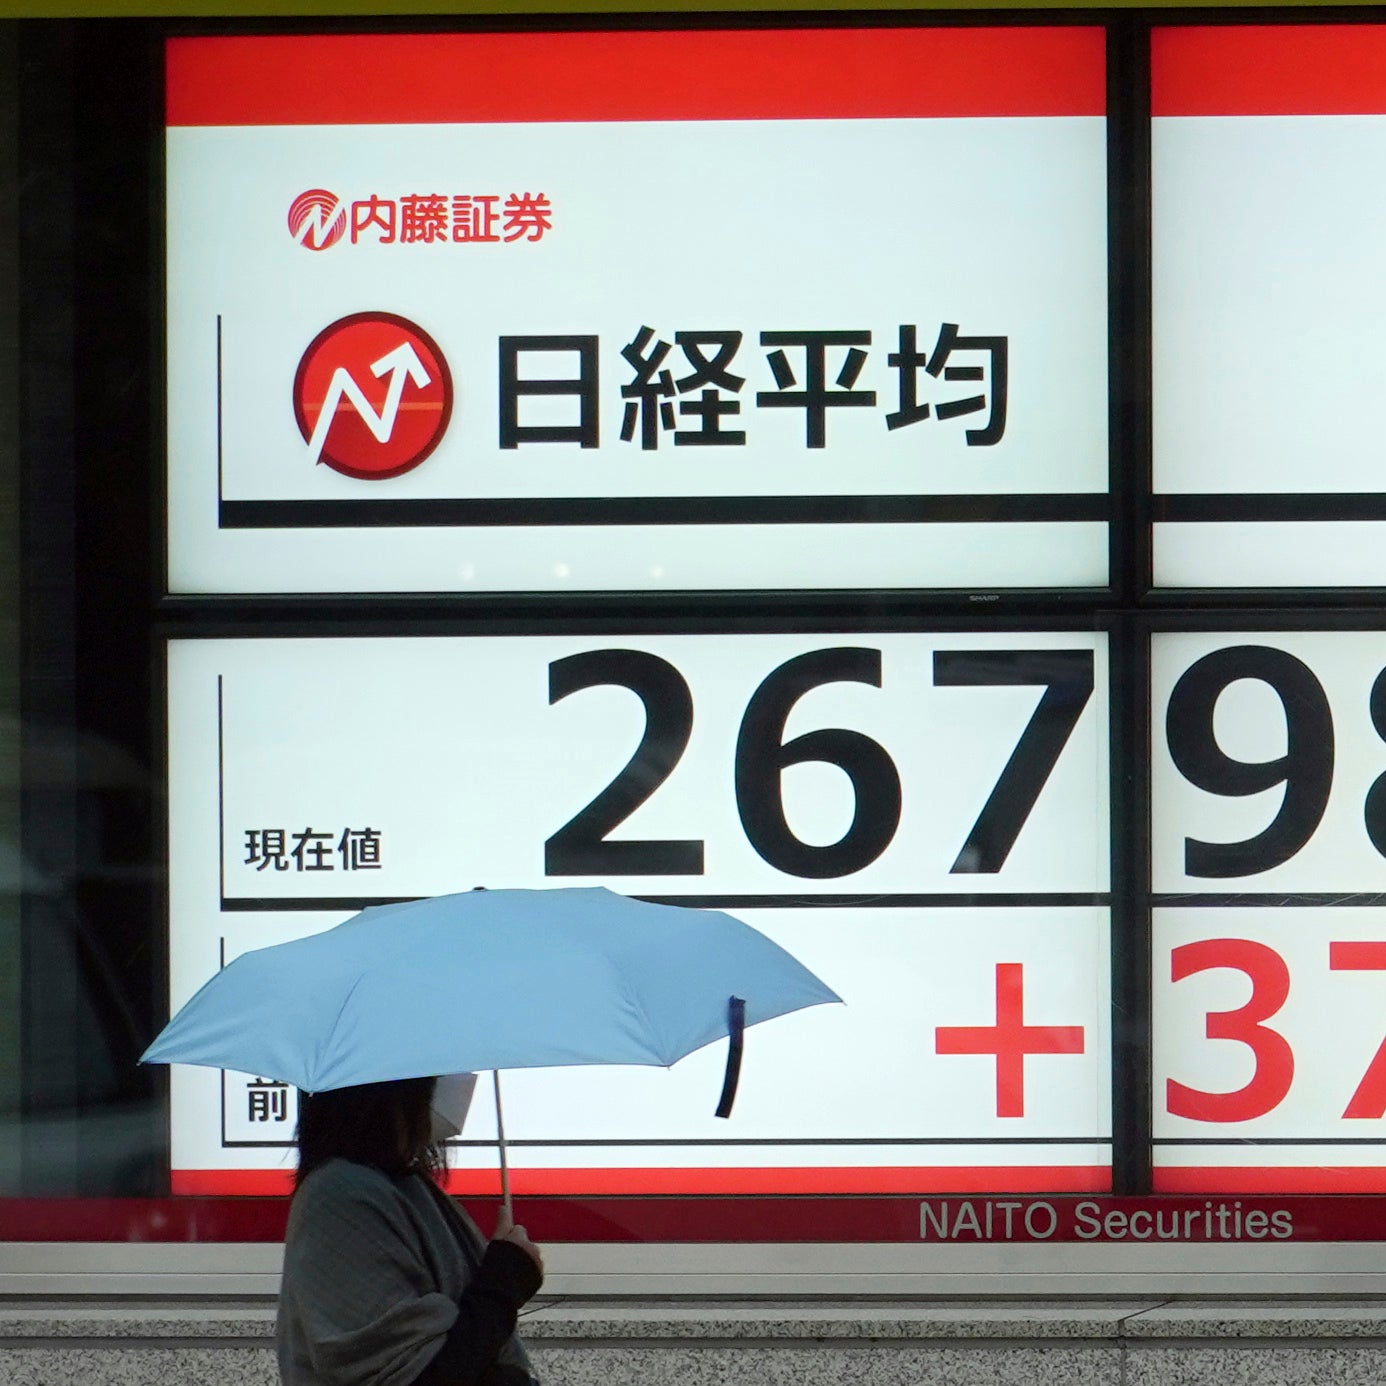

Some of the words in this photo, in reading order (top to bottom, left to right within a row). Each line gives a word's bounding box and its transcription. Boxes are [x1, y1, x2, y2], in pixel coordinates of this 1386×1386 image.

[351, 193, 551, 243] 内藤証券
[499, 323, 1007, 450] 日経平均
[245, 828, 381, 871] 現在値
[920, 1202, 1056, 1238] NAITO
[1075, 1202, 1293, 1238] Securities
